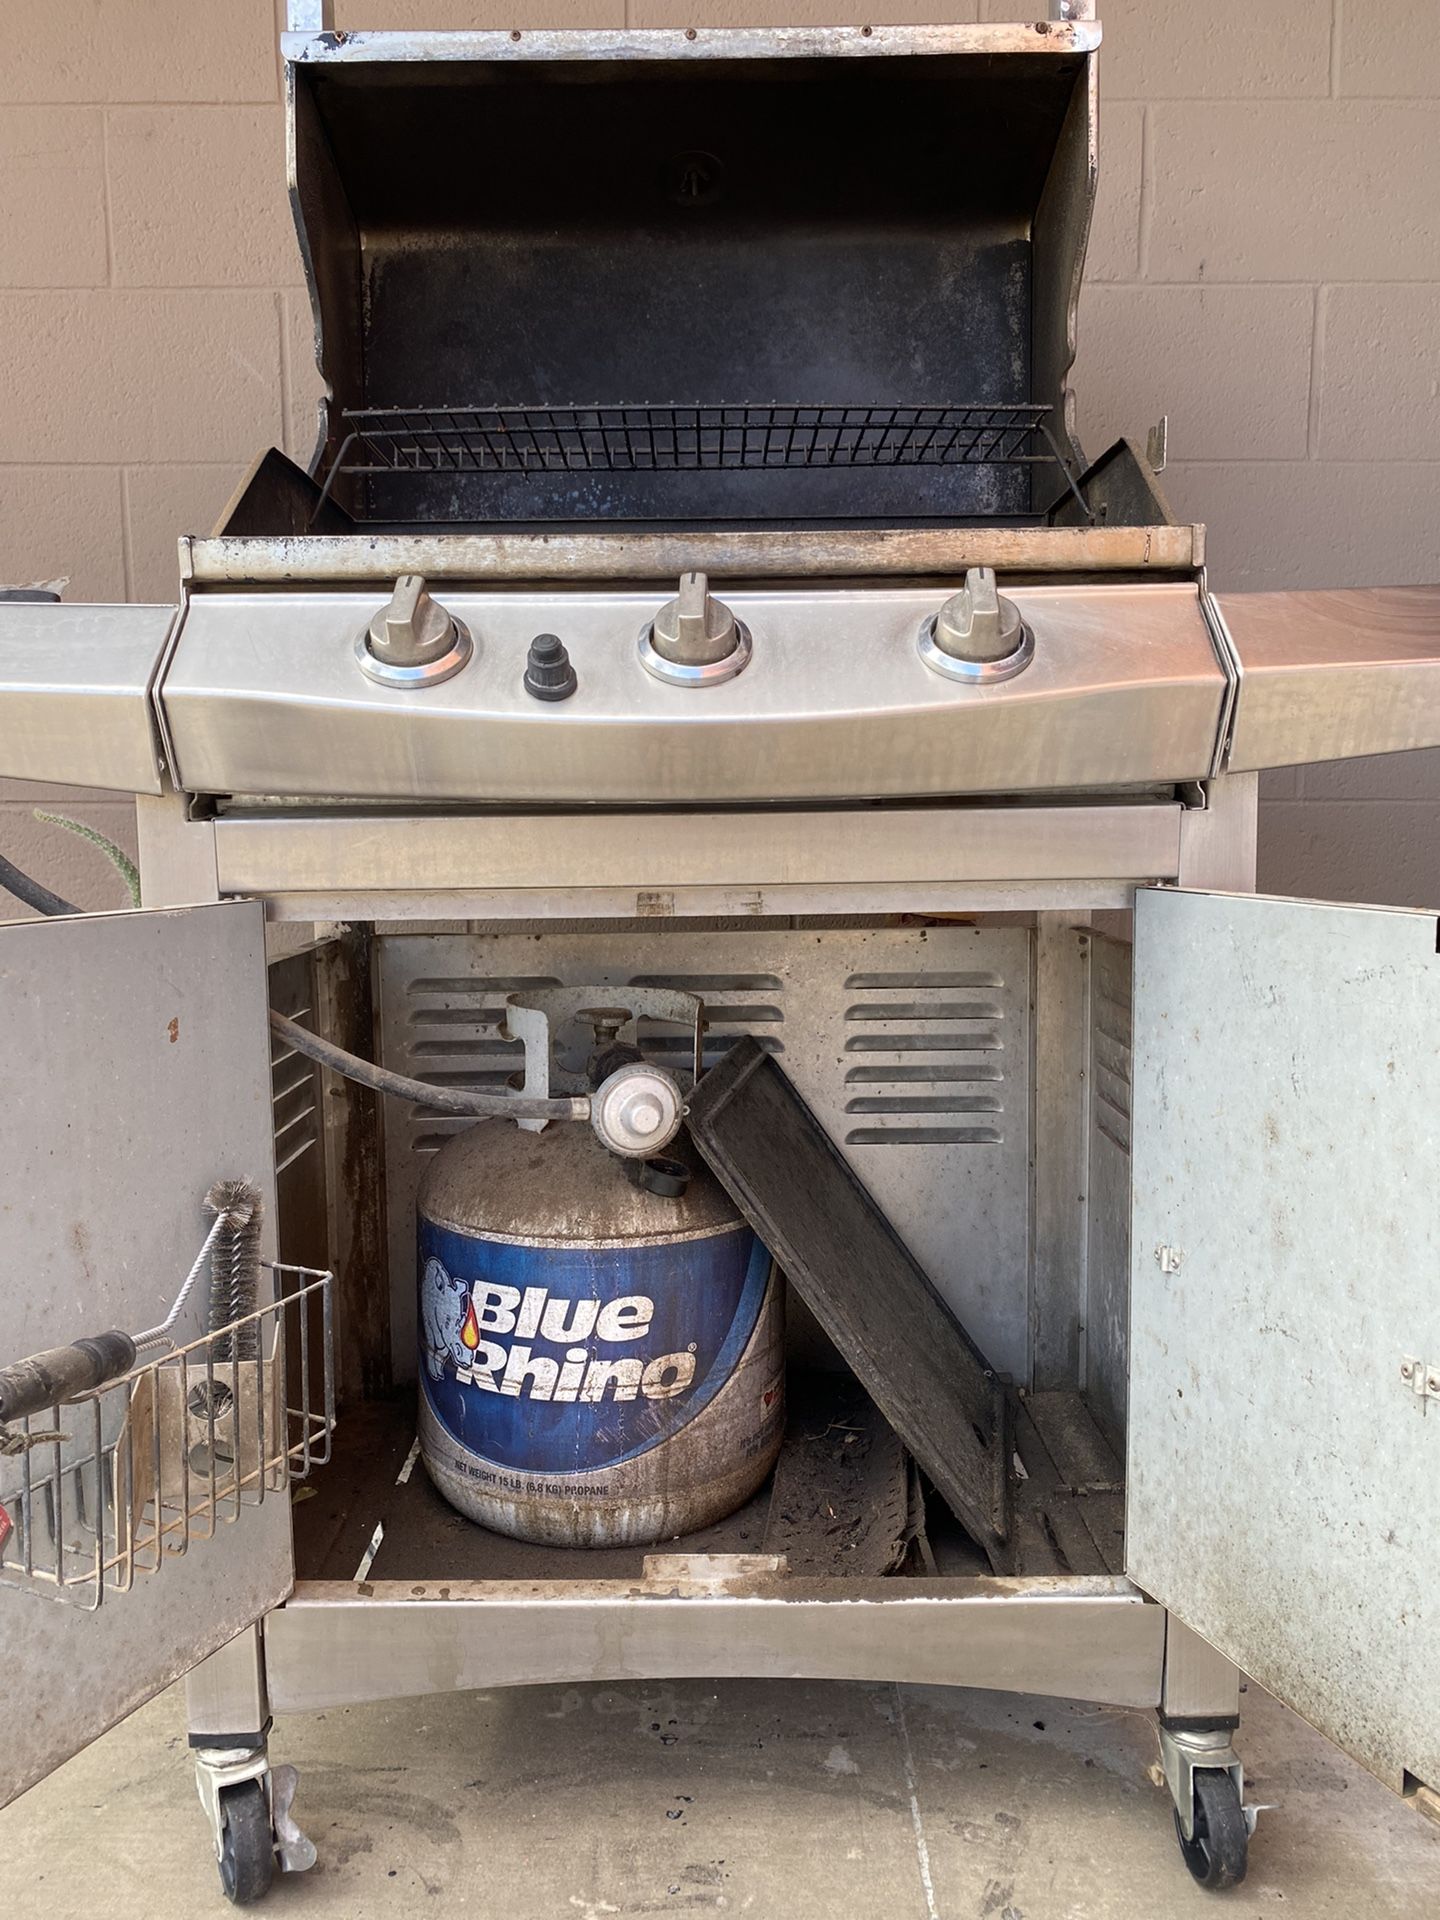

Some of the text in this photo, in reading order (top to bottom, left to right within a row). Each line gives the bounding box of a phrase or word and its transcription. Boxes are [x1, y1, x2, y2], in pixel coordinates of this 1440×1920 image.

[472, 1279, 655, 1343] Blue
[454, 1459, 467, 1474] NET
[468, 1466, 497, 1484] WEIGHT
[499, 1475, 509, 1487] 15
[510, 1479, 525, 1490] LB.
[545, 1483, 562, 1495] KG)
[564, 1485, 609, 1496] PROPANE
